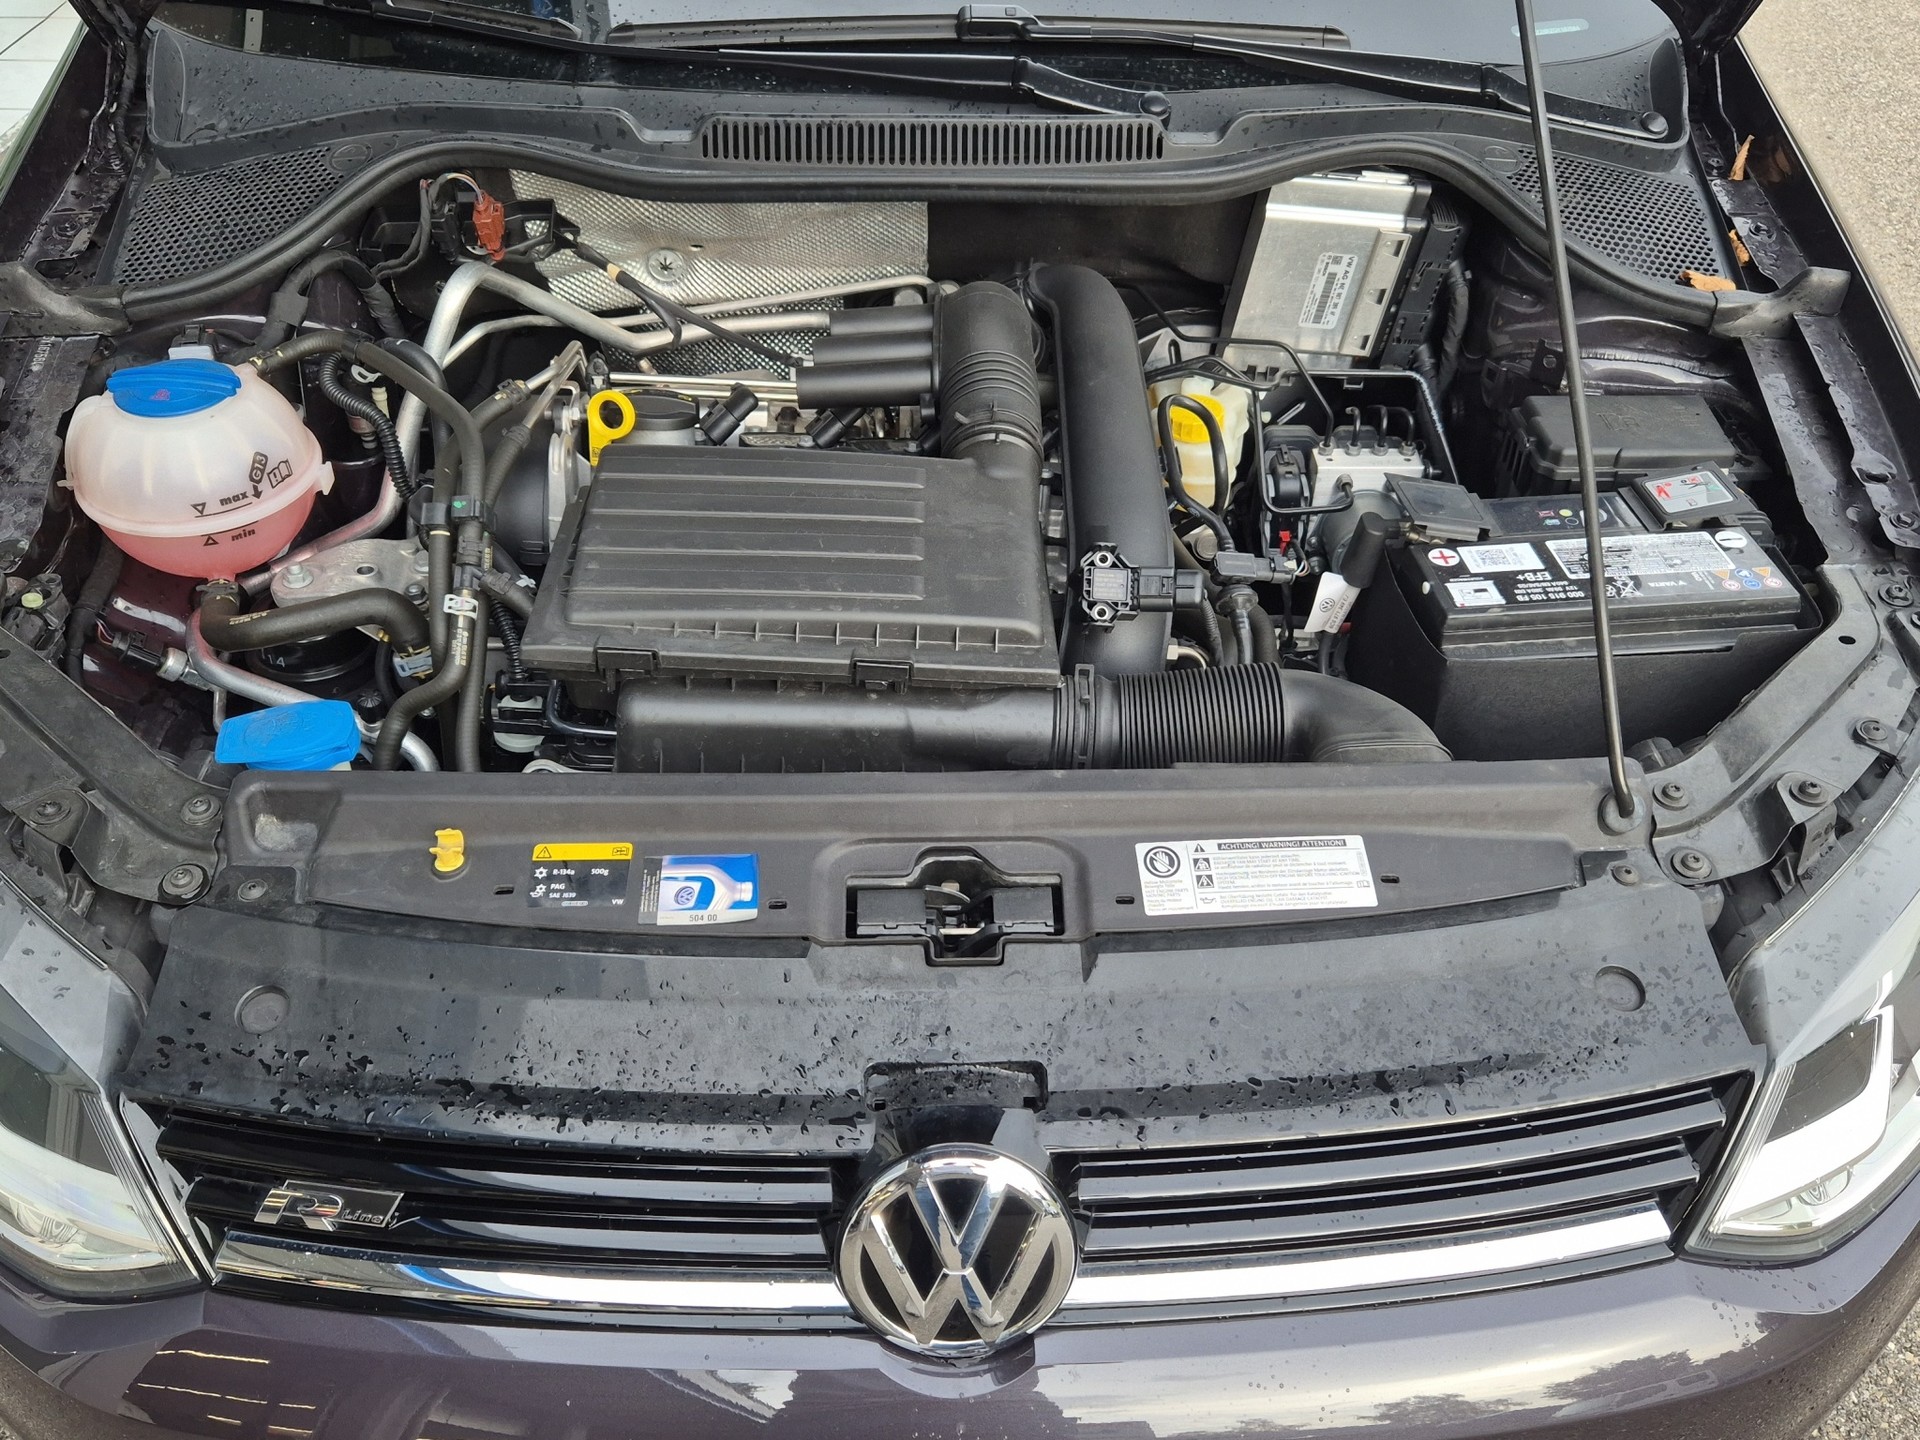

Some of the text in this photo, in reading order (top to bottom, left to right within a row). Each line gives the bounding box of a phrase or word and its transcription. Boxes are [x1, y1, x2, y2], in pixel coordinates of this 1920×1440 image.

[251, 455, 266, 480] G13
[219, 491, 249, 506] max
[231, 528, 256, 541] min
[1516, 571, 1552, 581] EFB+
[1221, 839, 1345, 850] ACHTUNG! WARNING! ATTENTION!
[591, 868, 609, 876] 500g
[689, 913, 718, 922] 504 00
